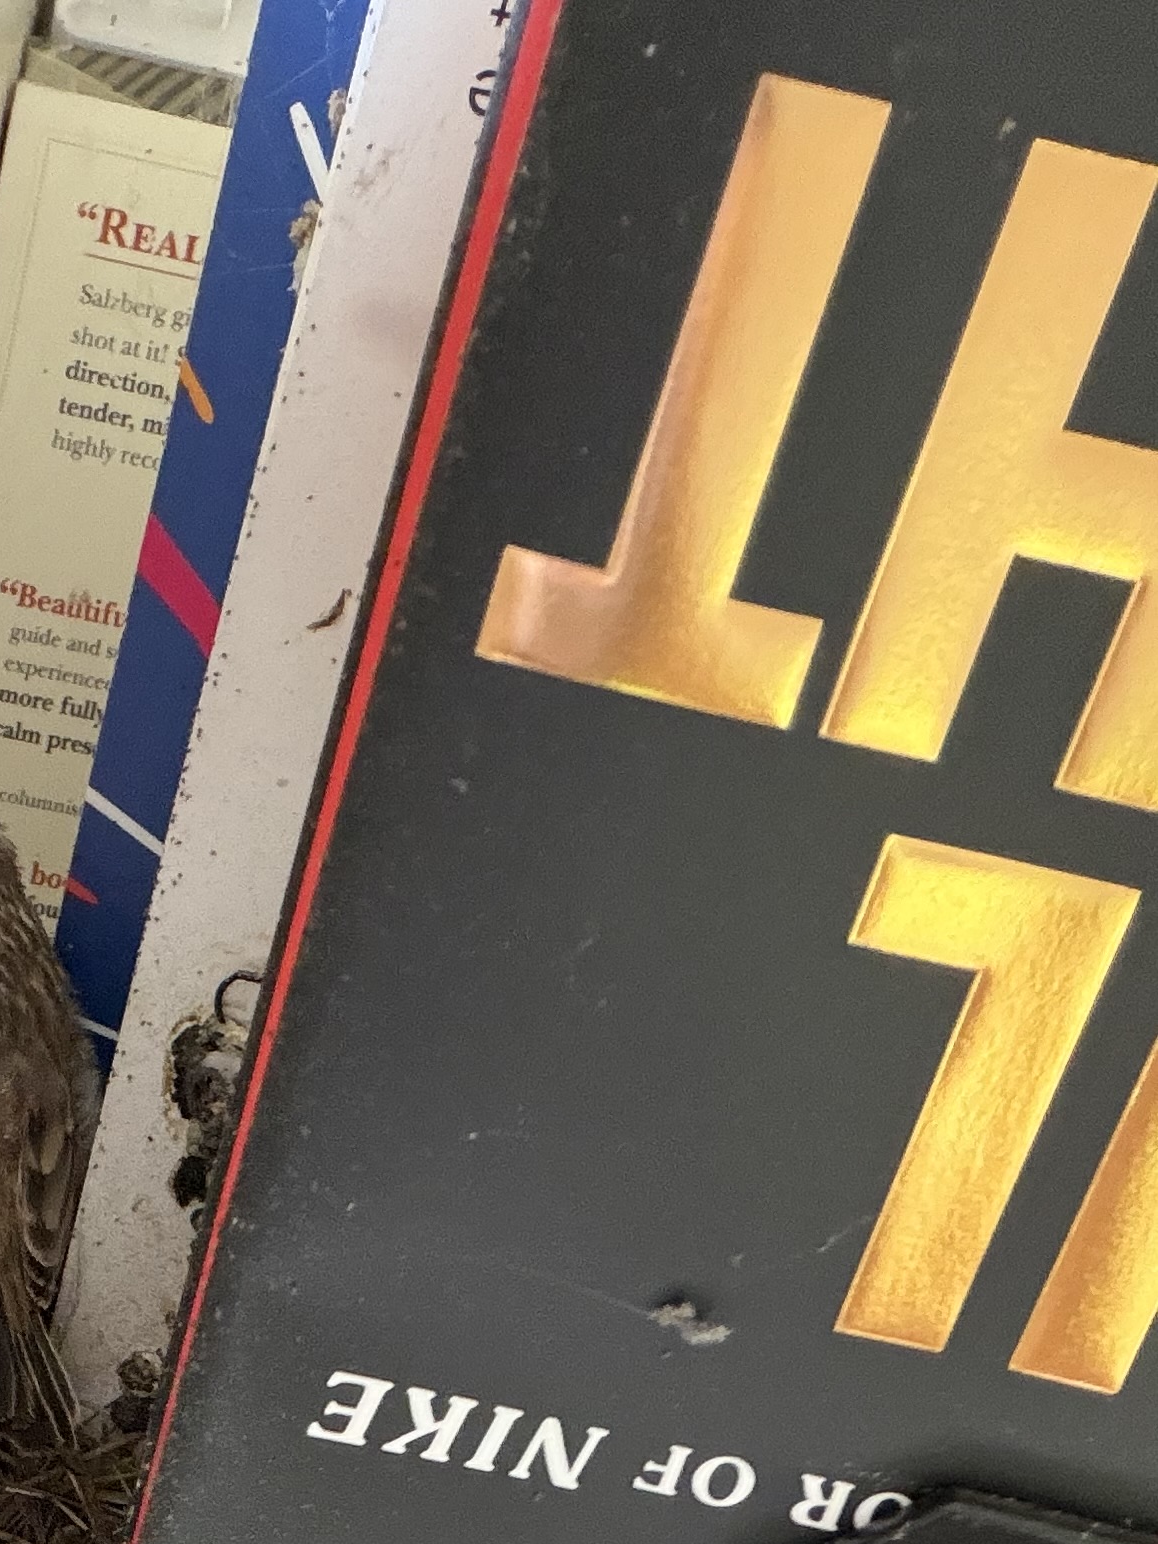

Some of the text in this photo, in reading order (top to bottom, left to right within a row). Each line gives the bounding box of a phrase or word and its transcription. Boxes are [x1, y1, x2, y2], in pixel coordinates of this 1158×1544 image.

[79, 283, 168, 328] Salzberg
[69, 324, 116, 352] shot
[120, 340, 141, 358] at
[65, 360, 171, 405] direction,
[59, 396, 134, 432] tender,
[51, 428, 117, 465] highly
[8, 626, 62, 650] guide
[66, 638, 102, 657] and
[45, 735, 97, 757] pres
[306, 1370, 611, 1491] NIKE
[632, 1444, 757, 1508] OF
